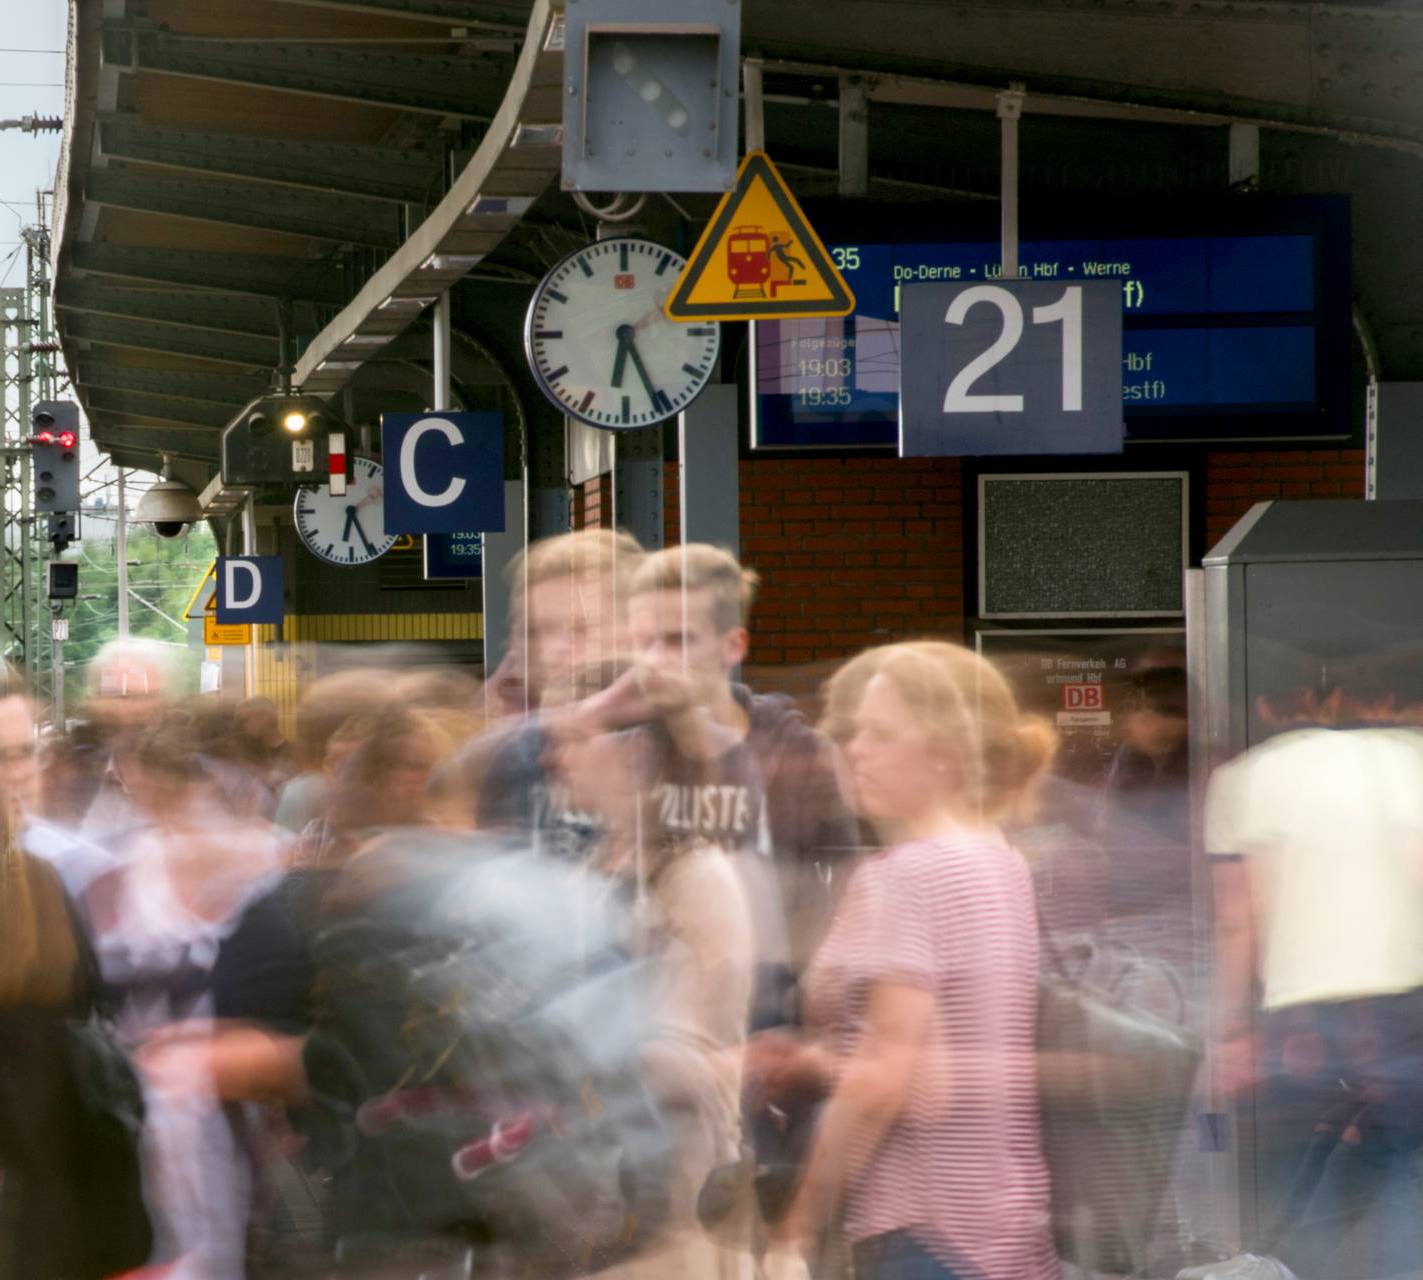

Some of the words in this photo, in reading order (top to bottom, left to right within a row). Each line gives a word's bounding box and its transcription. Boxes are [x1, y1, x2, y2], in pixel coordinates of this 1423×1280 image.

[893, 265, 961, 280] Do-Derne
[984, 263, 1028, 279] Lün
[1034, 262, 1059, 277] Hbf
[1083, 261, 1131, 275] Werne
[943, 285, 1083, 414] 21
[799, 358, 851, 377] 19:03
[799, 387, 852, 406] 19:35
[398, 416, 468, 508] C
[450, 543, 481, 556] 19:35
[225, 560, 262, 609] D
[1067, 687, 1100, 708] DB
